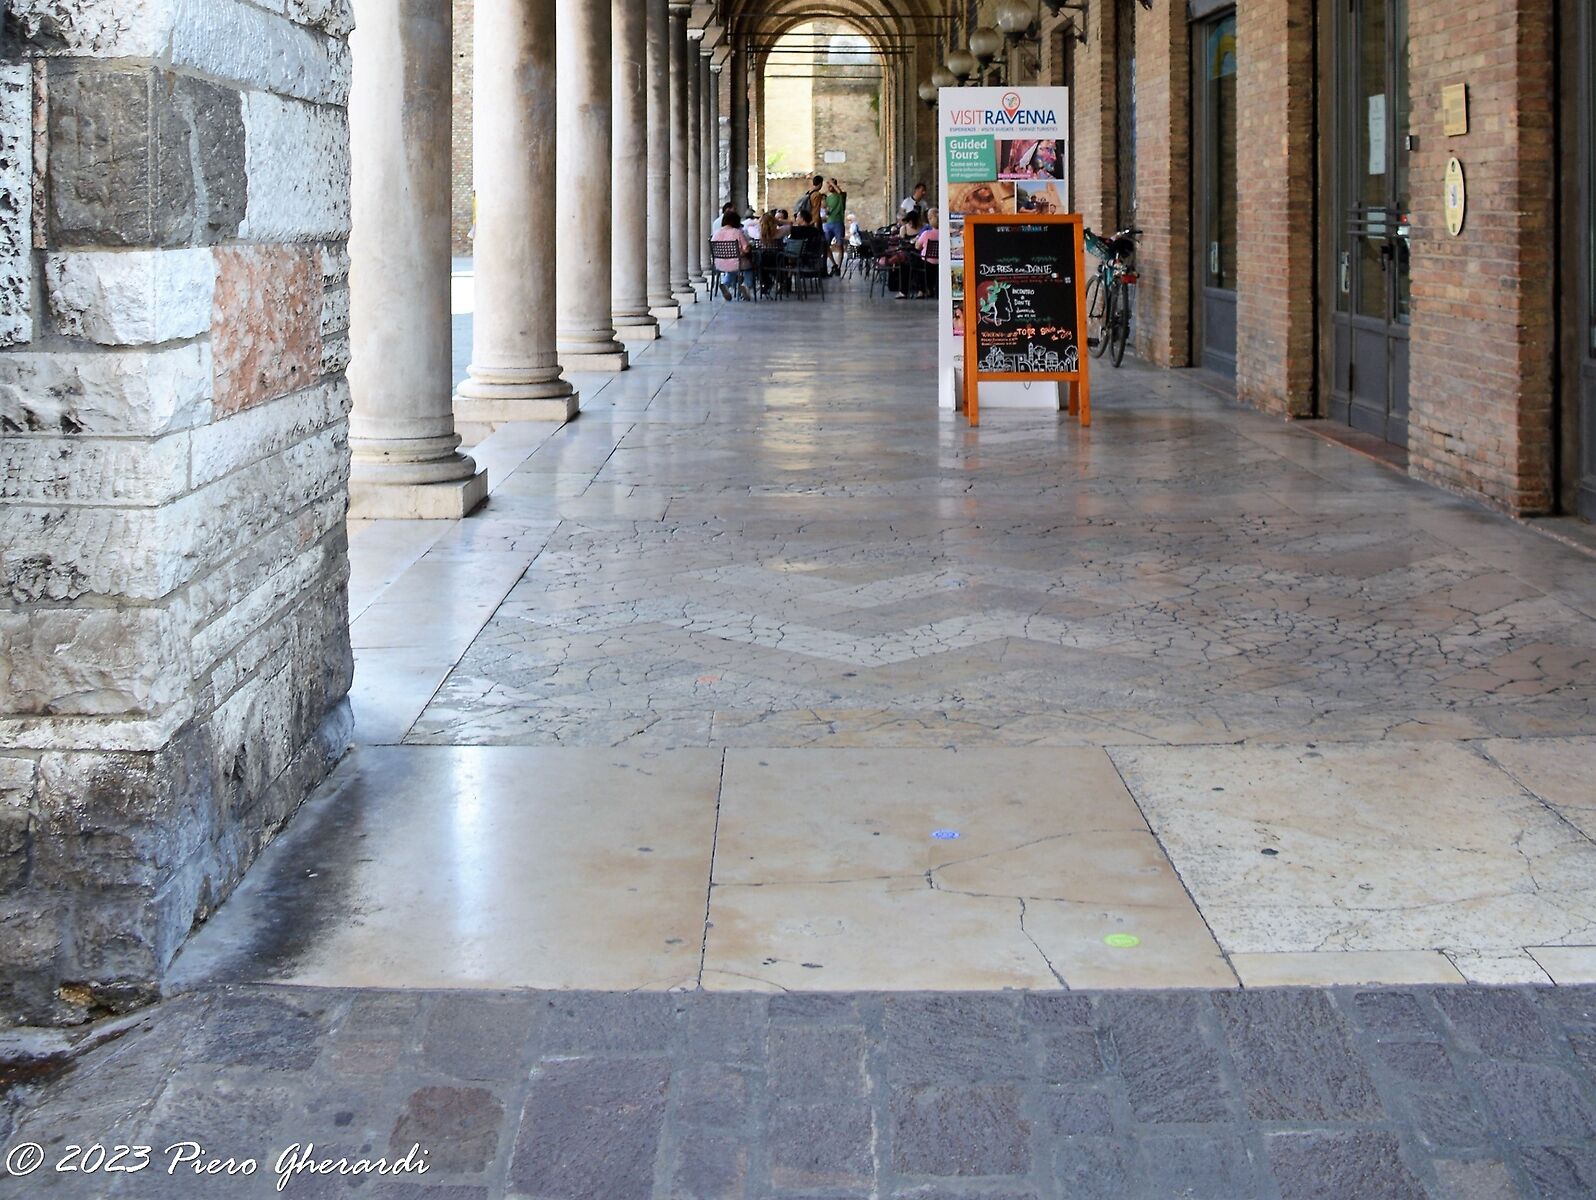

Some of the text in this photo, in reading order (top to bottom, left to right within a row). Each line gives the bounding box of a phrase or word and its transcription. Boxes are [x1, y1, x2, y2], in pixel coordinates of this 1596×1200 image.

[950, 139, 987, 150] Guided
[950, 150, 979, 160] Tours
[1025, 264, 1052, 274] DANTE
